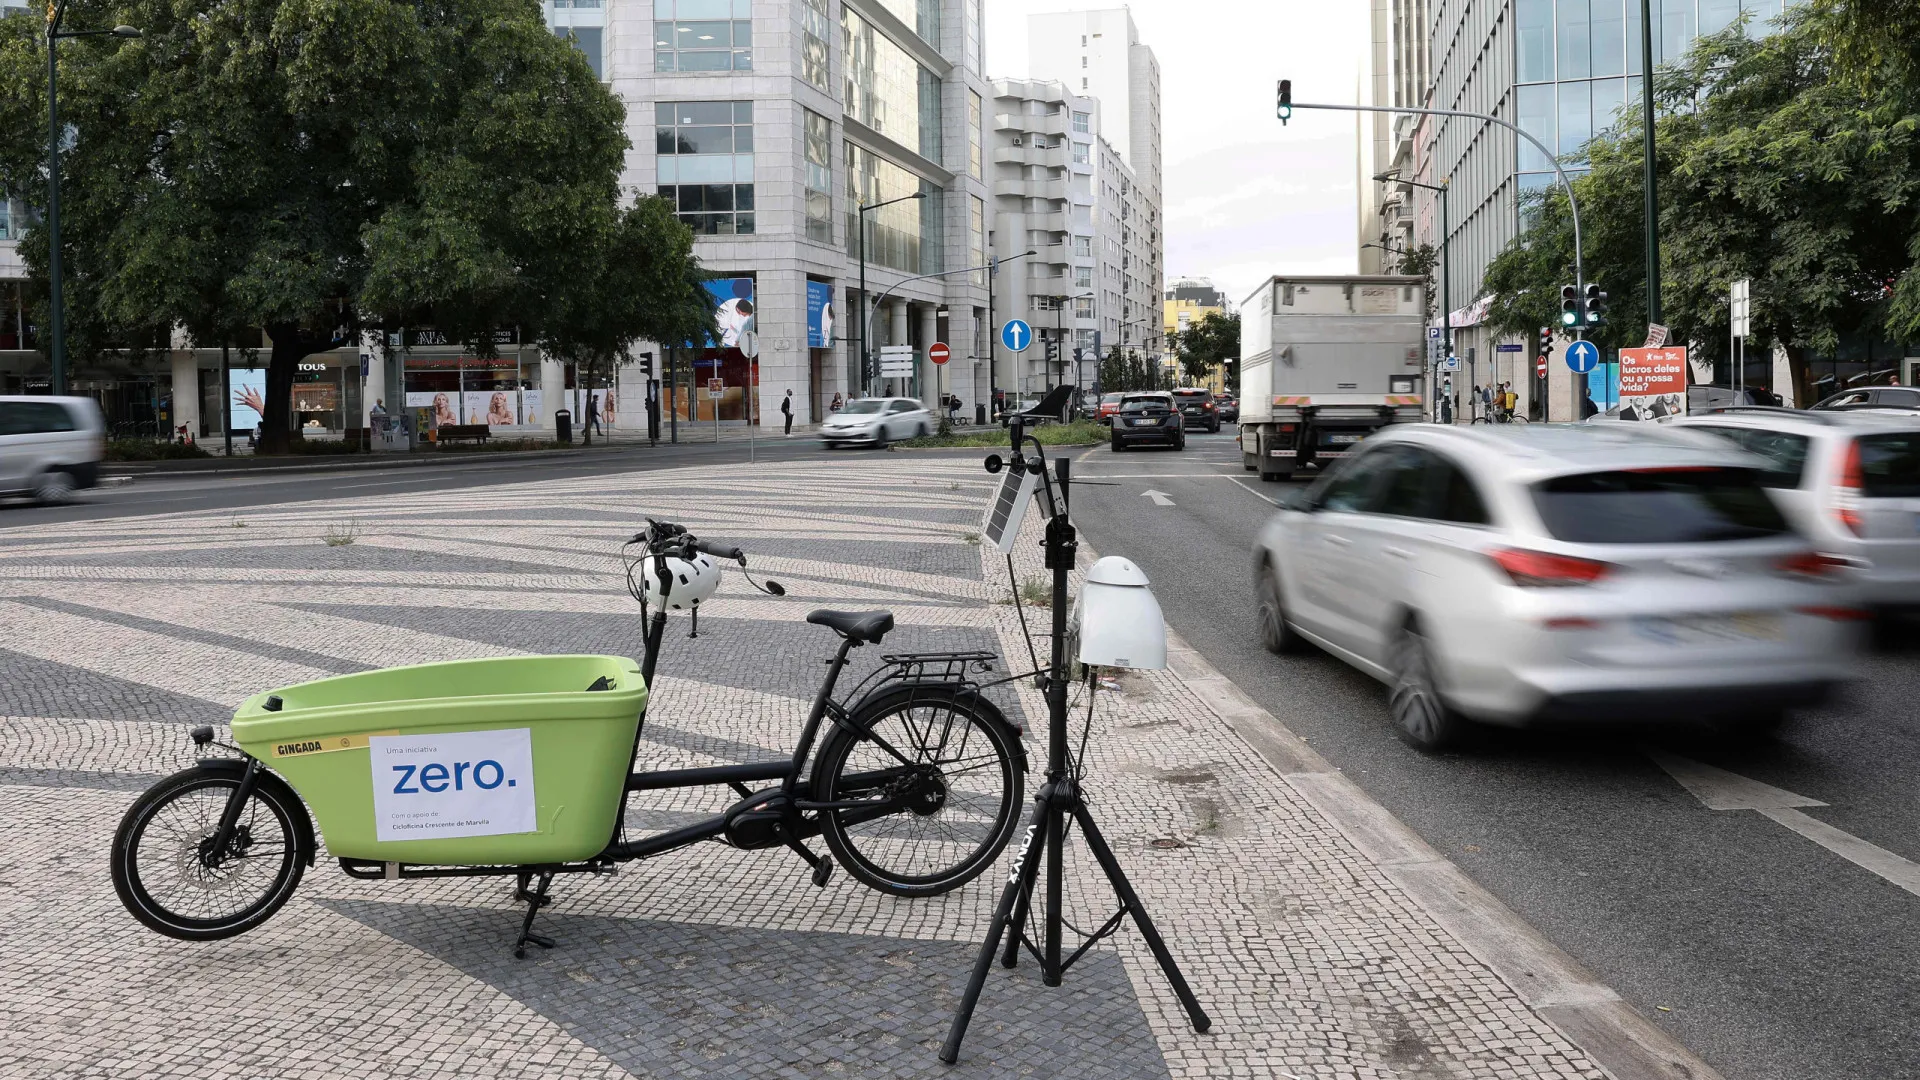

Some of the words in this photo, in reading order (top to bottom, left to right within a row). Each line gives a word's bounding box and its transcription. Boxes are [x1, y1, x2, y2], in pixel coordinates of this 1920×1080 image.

[1430, 329, 1438, 337] P
[1622, 356, 1636, 365] Os
[298, 363, 326, 371] TOUS
[1622, 365, 1652, 374] lucros
[1653, 364, 1680, 373] deles
[1622, 375, 1635, 383] ou
[1623, 382, 1649, 392] vida?
[277, 740, 323, 755] GINGADA
[405, 746, 438, 754] iniciativa
[392, 759, 516, 794] zero.
[412, 812, 430, 820] apoio
[425, 821, 455, 829] Crescente
